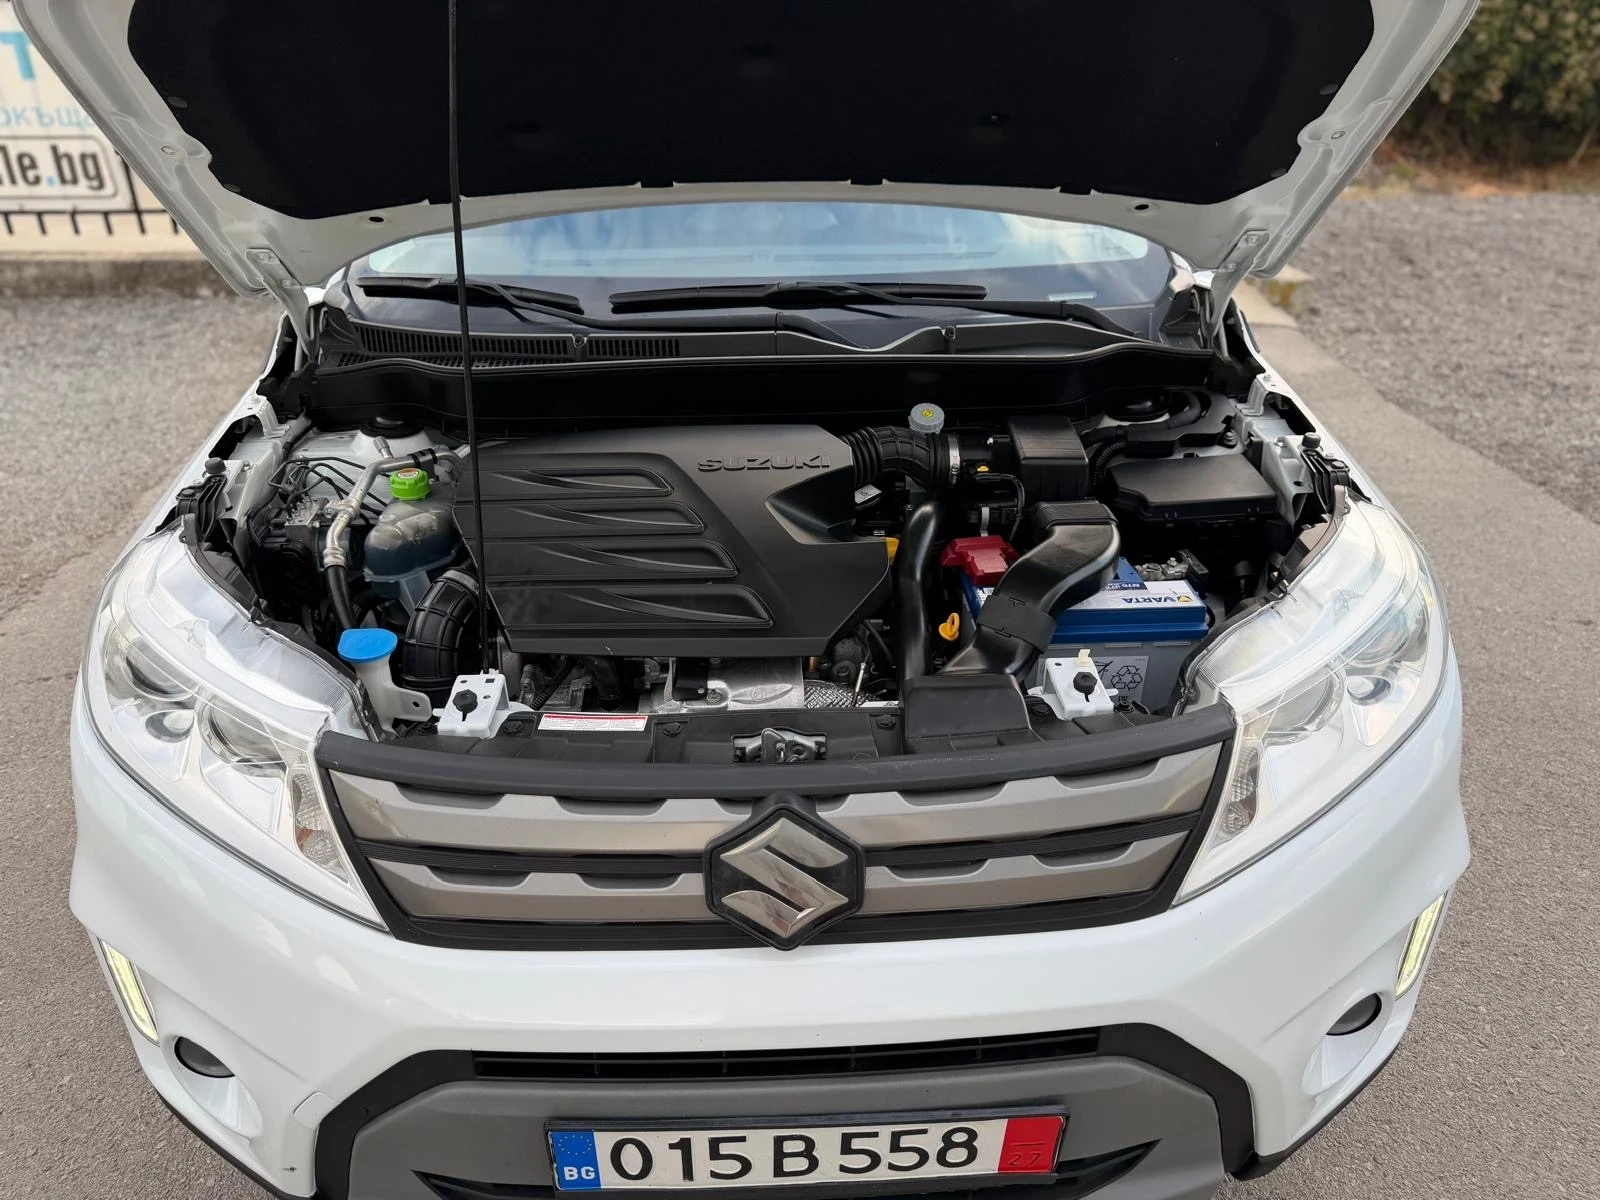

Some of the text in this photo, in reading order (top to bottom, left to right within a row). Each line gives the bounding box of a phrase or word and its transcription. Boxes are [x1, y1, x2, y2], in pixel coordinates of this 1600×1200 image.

[0, 144, 105, 191] le.bg
[697, 455, 830, 473] SUZUKI
[1122, 595, 1177, 604] VARTA
[610, 1126, 979, 1182] 015 B 558
[563, 1166, 596, 1181] BG
